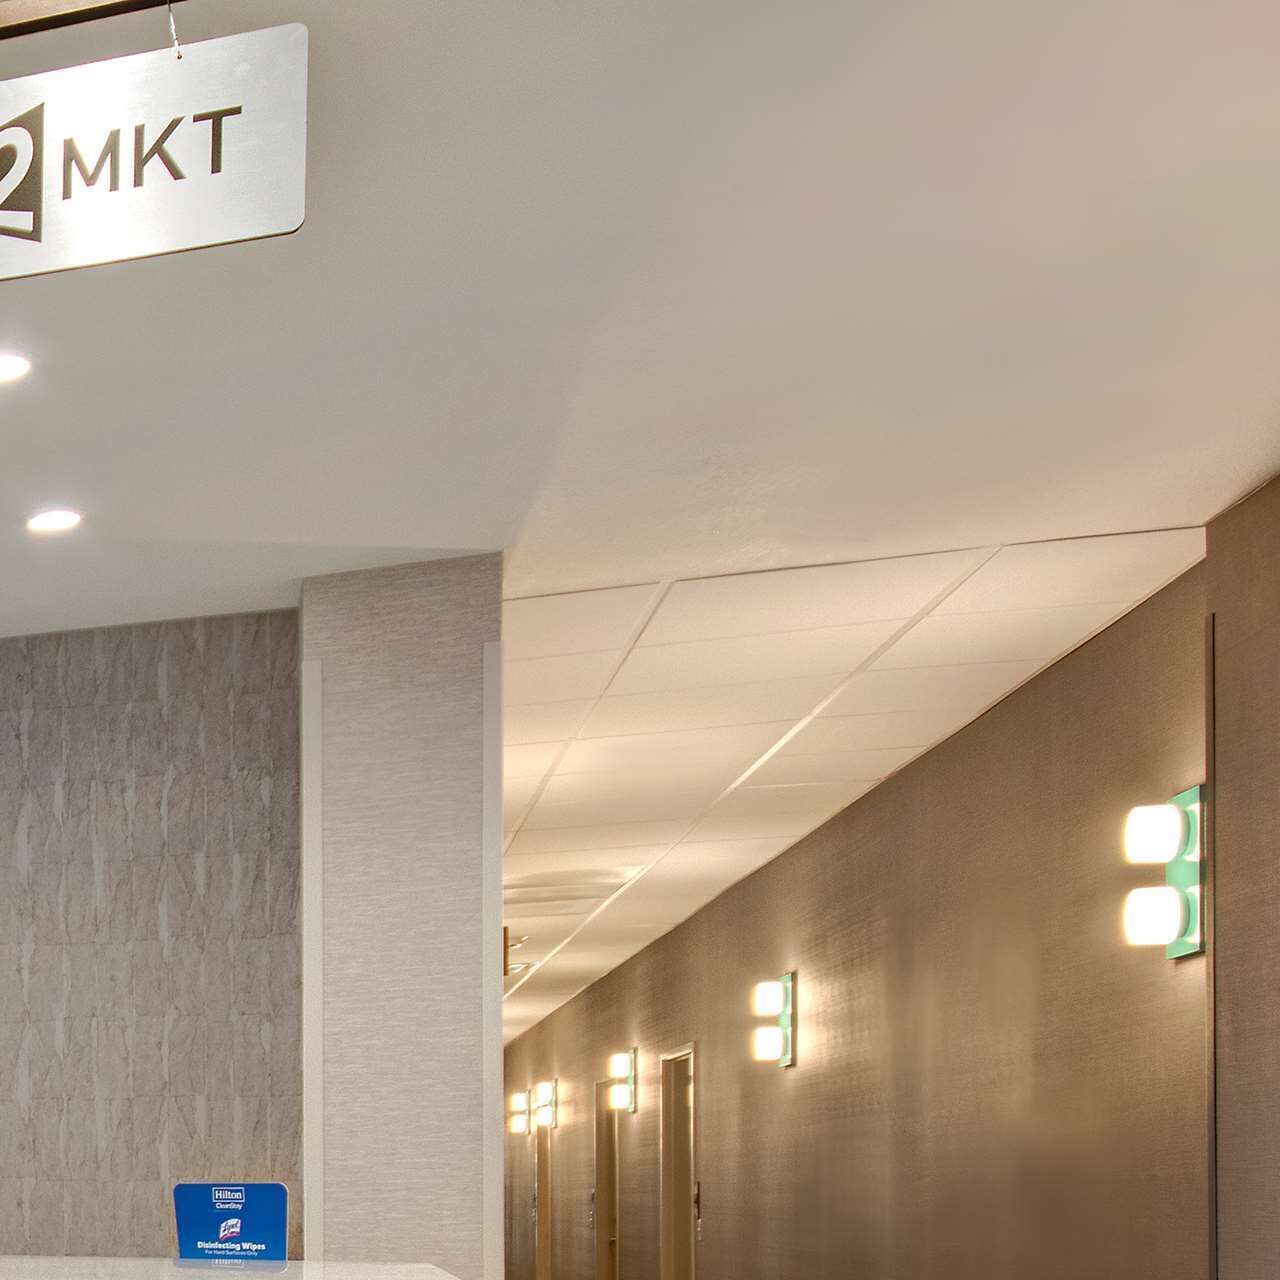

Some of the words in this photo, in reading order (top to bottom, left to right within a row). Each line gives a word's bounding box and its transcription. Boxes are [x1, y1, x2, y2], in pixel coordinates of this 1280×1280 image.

[61, 105, 242, 200] MKT
[215, 1190, 242, 1199] Hilton
[197, 1241, 241, 1251] Disinfecting
[242, 1242, 266, 1251] Wipes
